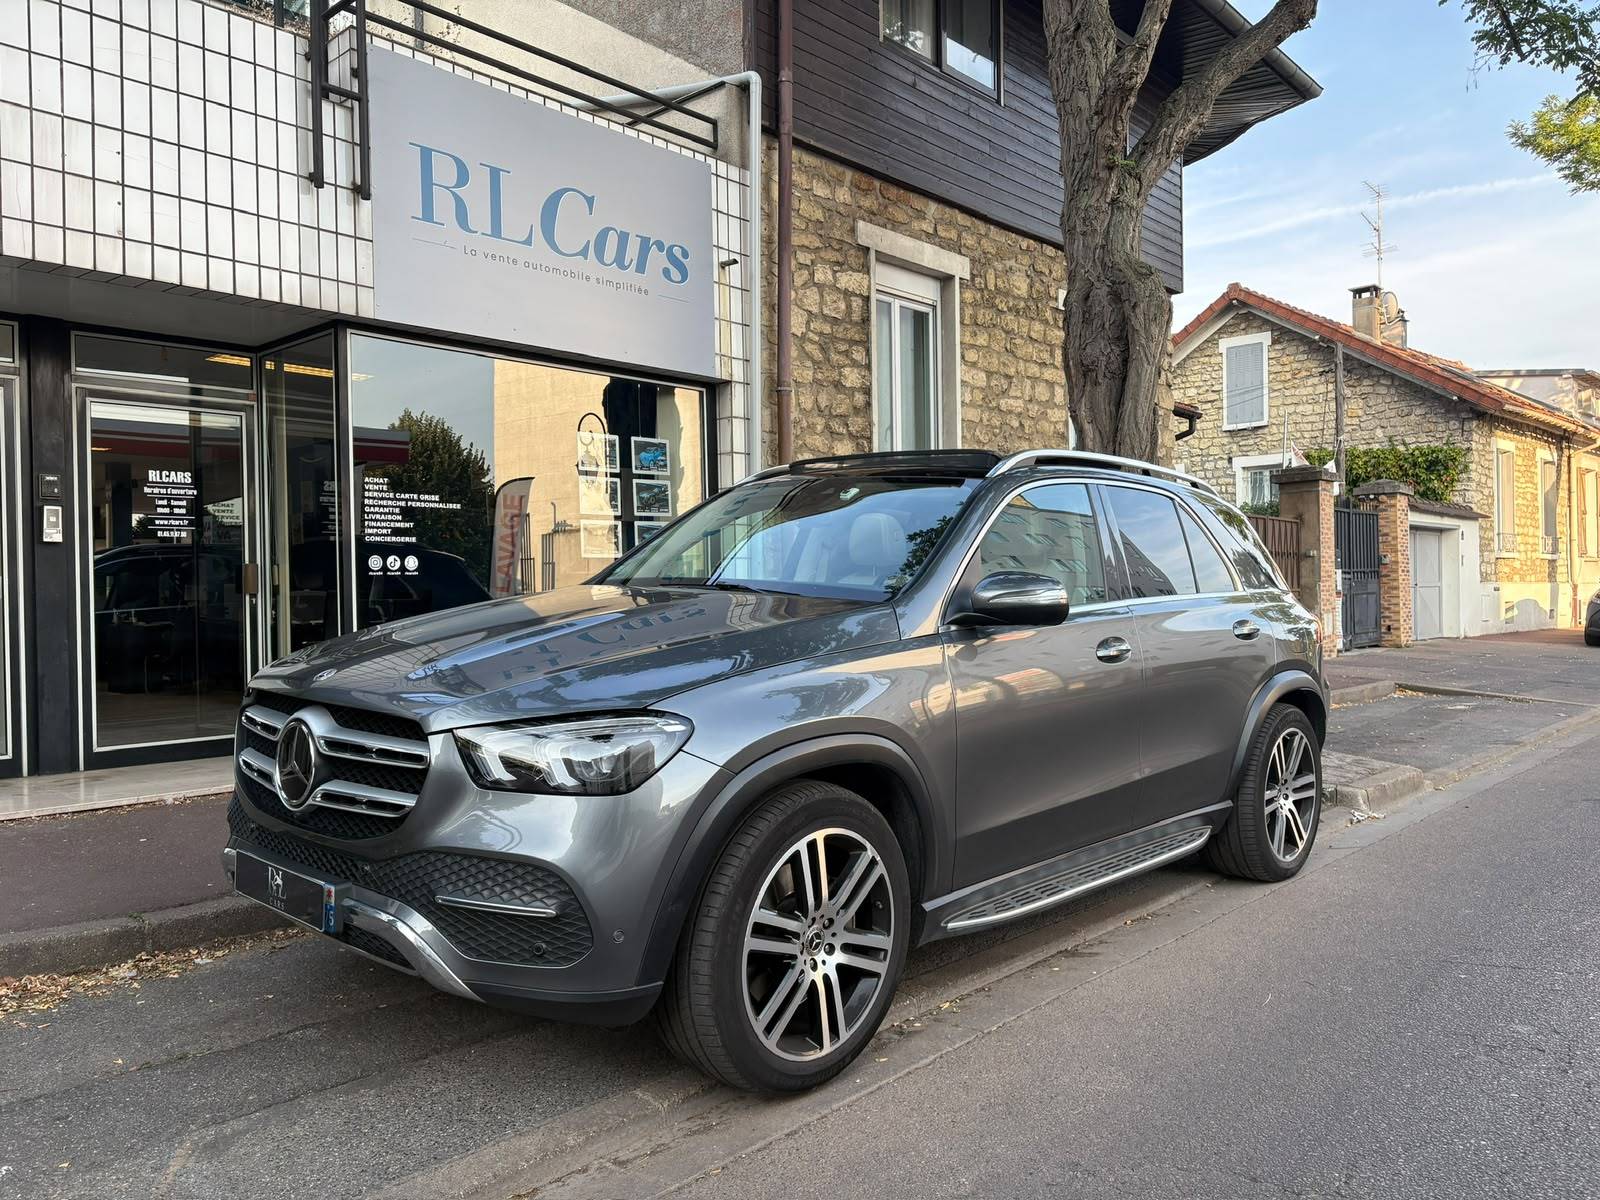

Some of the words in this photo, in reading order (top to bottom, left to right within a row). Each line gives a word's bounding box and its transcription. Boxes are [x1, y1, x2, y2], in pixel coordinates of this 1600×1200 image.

[463, 246, 477, 257] La
[483, 251, 519, 266] vente
[523, 259, 591, 283] automobile
[595, 275, 649, 297] simplifiée
[148, 470, 192, 484] RLCARS
[143, 486, 167, 495] Horaires
[364, 491, 394, 499] SERVICE
[364, 498, 407, 507] RECHERCHE
[364, 506, 400, 514] GARANTIE
[364, 513, 402, 521] LIVRAISON
[365, 535, 417, 543] CONCIERGERIE
[497, 494, 525, 592] LAVAGE
[269, 897, 285, 910] CARS
